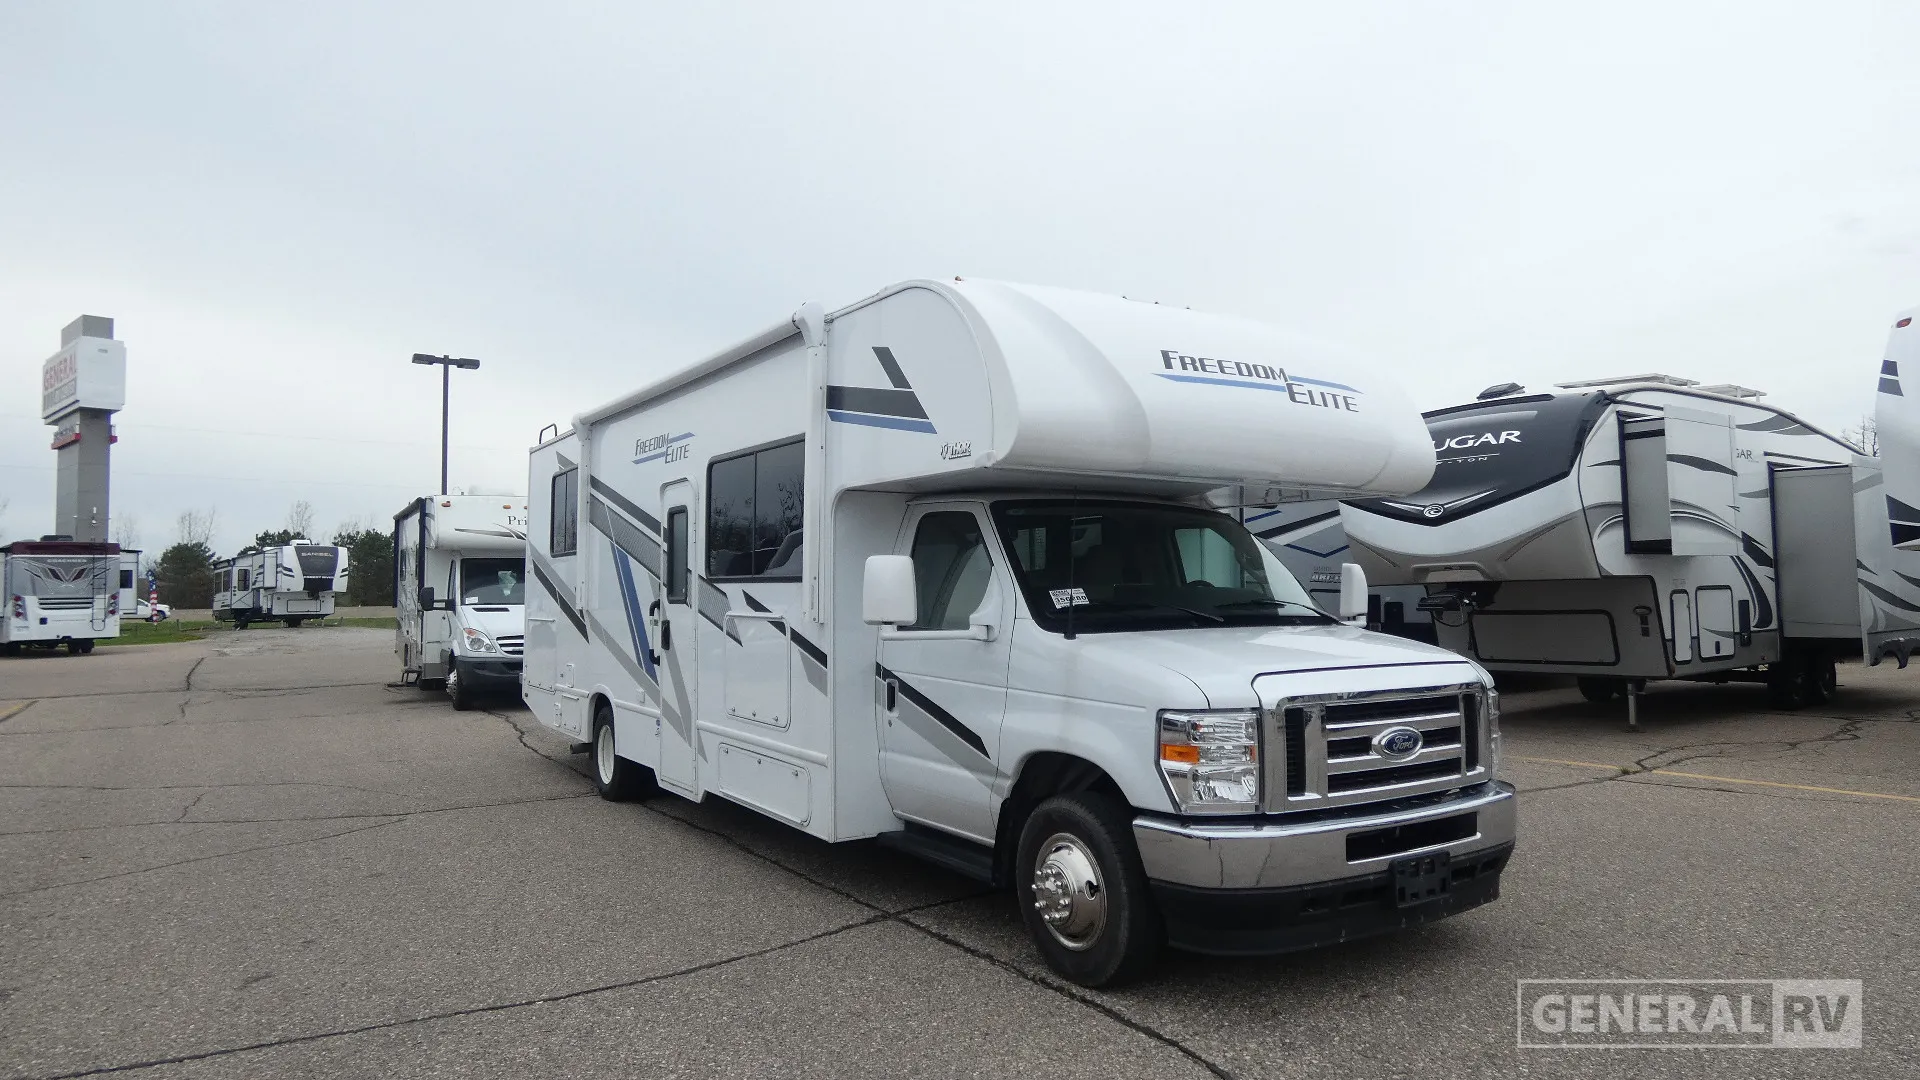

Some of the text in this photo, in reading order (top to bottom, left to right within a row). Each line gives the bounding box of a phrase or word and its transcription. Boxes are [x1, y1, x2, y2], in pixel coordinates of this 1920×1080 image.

[1160, 350, 1289, 382] FREEDOM
[1286, 382, 1360, 413] ELITE
[635, 433, 669, 456] FREEDOM
[665, 443, 690, 464] ELITE
[1393, 735, 1414, 751] Ford
